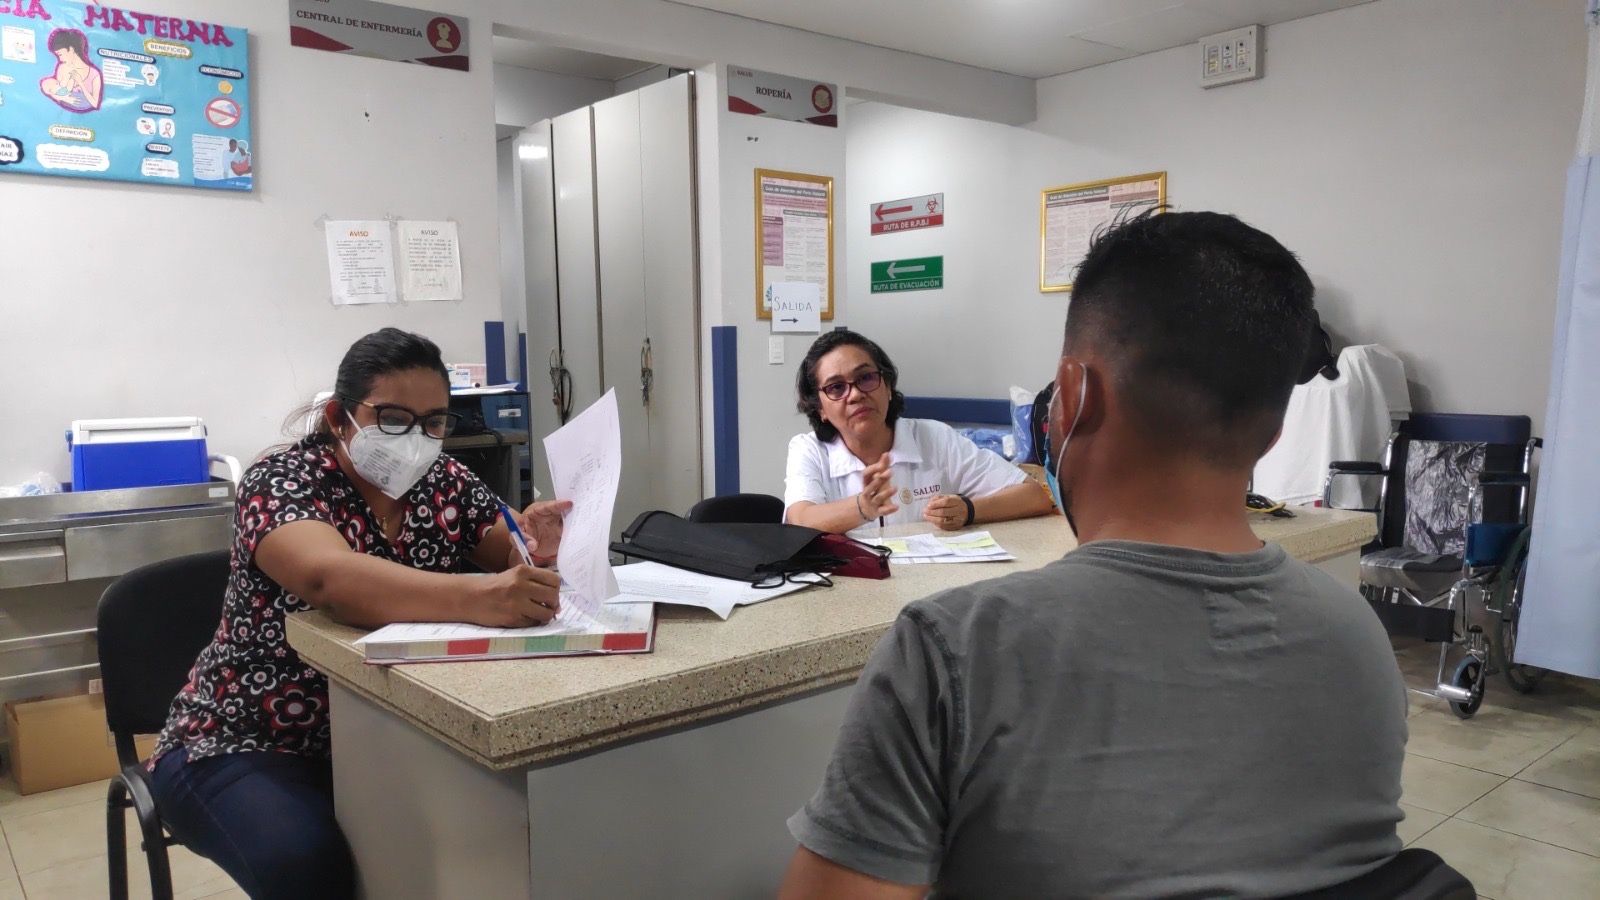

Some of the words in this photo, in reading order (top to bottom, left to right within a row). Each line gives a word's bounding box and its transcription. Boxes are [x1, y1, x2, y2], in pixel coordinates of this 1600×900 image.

[84, 4, 234, 47] MATERNA
[296, 9, 344, 24] CENTRAL
[345, 18, 359, 27] DE
[360, 21, 423, 38] ENFERMERÍA
[100, 49, 153, 62] NUTRICIONALES
[150, 44, 187, 55] BENEFICIOS
[756, 86, 792, 100] ROPERÍA
[883, 223, 899, 231] RUTA
[873, 283, 889, 291] RUTA
[890, 282, 898, 290] DE
[899, 279, 940, 289] EVACUACIÓN
[773, 296, 813, 312] SALIDA
[913, 484, 941, 496] SALUD
